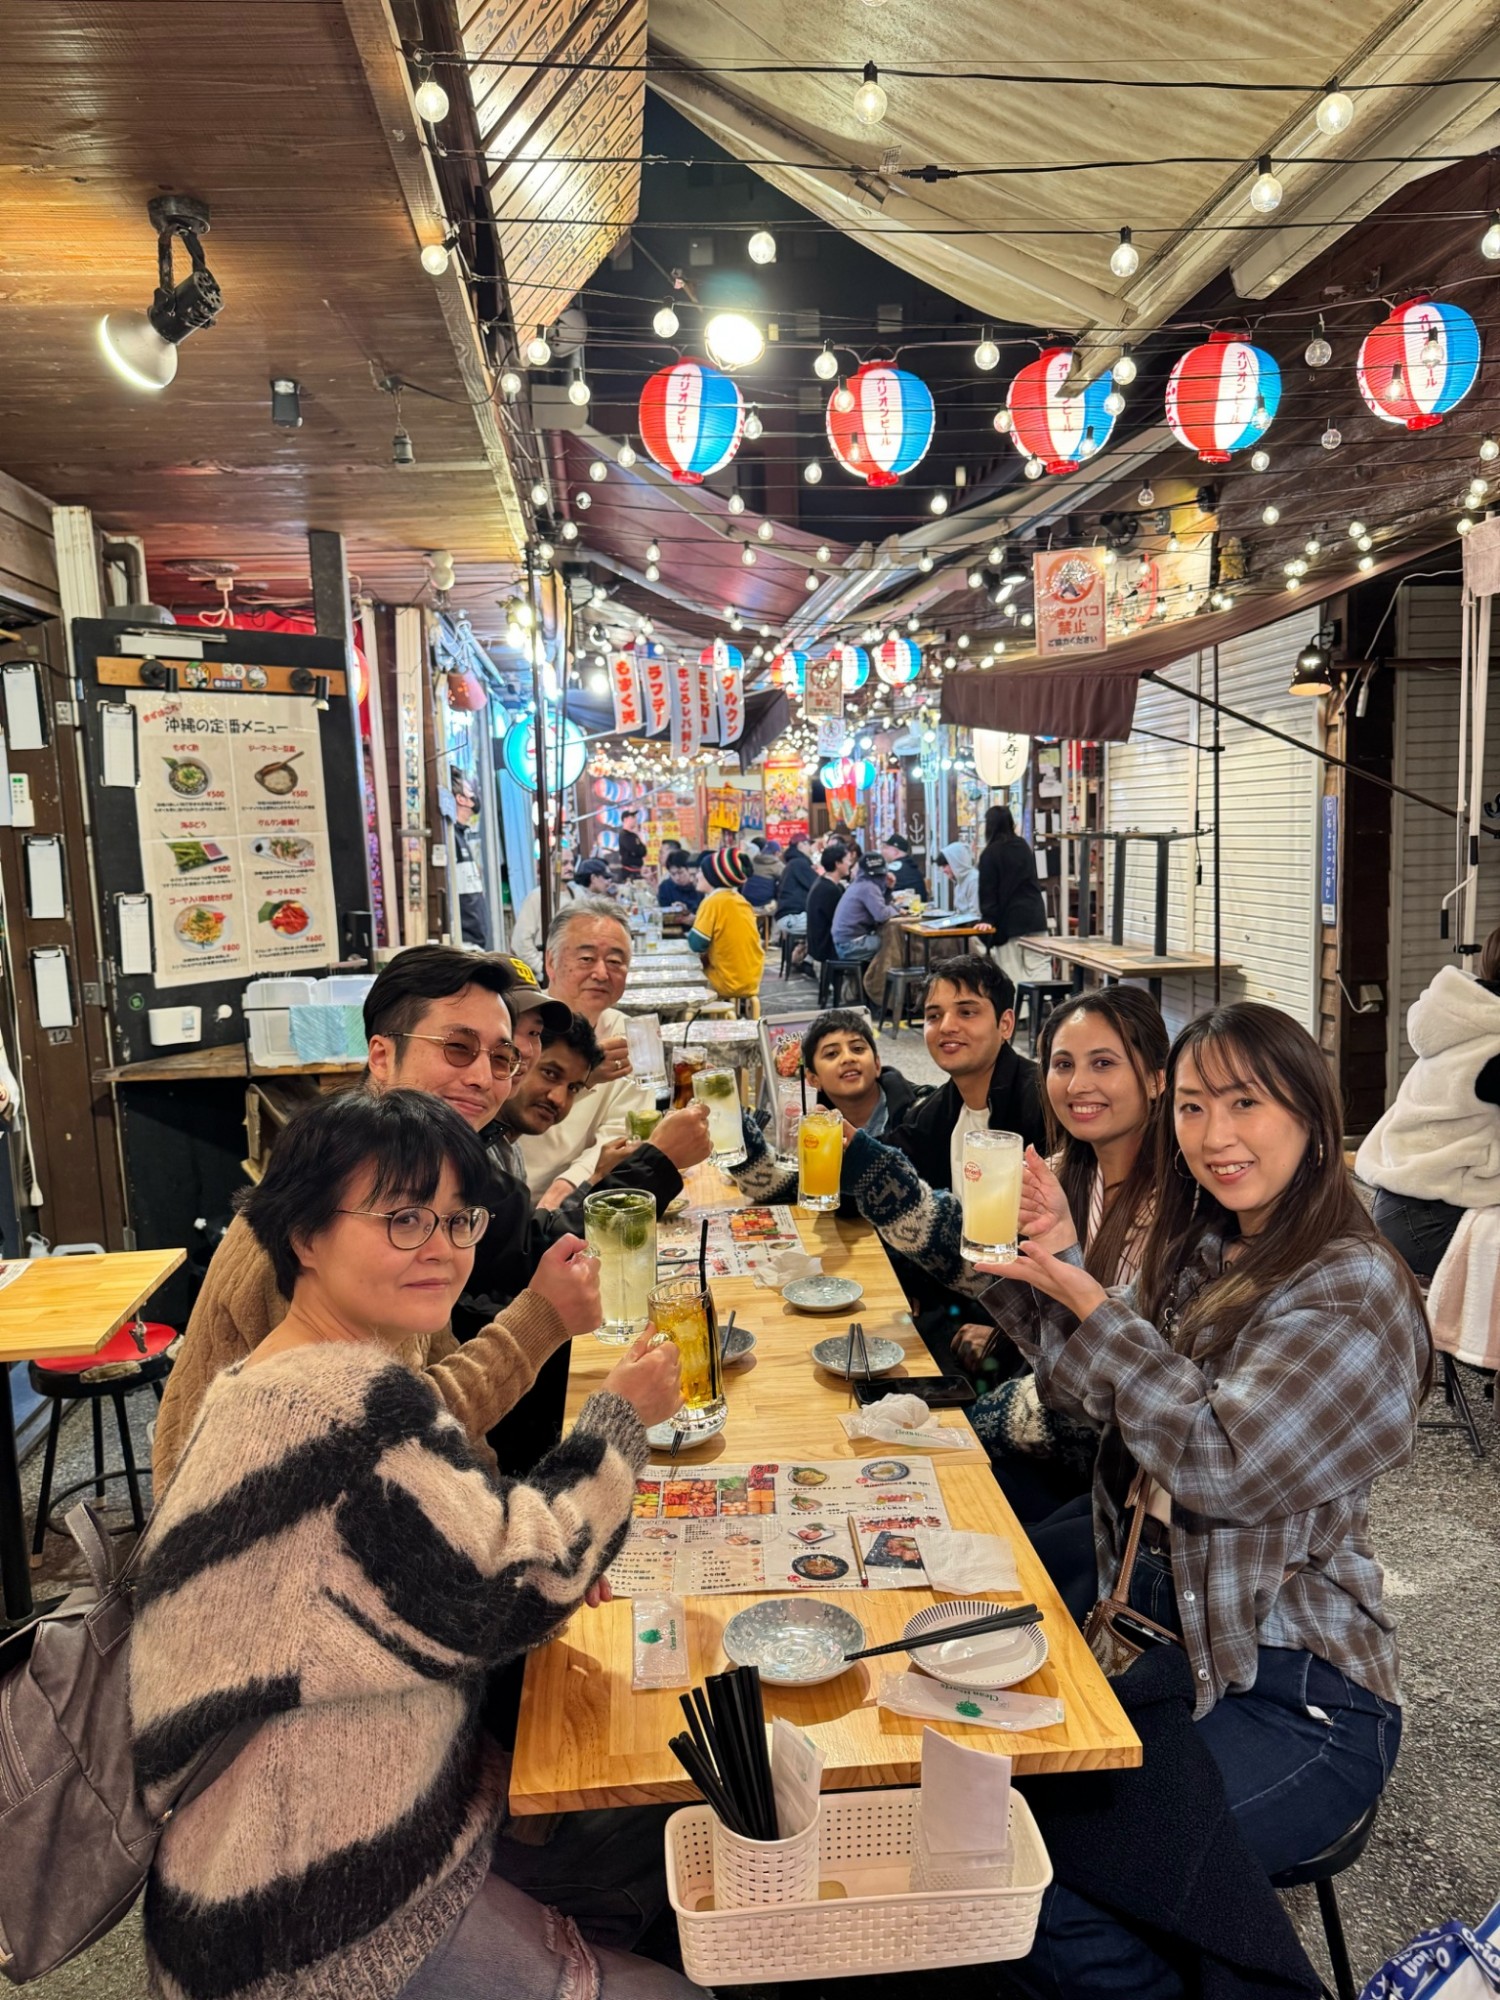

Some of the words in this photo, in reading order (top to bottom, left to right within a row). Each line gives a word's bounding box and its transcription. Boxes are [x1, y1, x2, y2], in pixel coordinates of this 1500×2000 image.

[677, 372, 692, 443] オリオンビール
[876, 377, 892, 446] オリオンビール
[1058, 363, 1074, 432] オビール
[1230, 351, 1248, 424] オリオンビール
[1045, 605, 1100, 620] きタバコ
[1047, 635, 1098, 647] ご協力ください
[1057, 619, 1087, 635] 禁止
[164, 717, 289, 734] 沖縄の定番メニュー
[647, 665, 665, 728] ラフテー
[699, 671, 711, 735] ミミガー
[721, 674, 738, 737] グルクン
[971, 1690, 999, 1702] Clean
[1462, 1927, 1500, 1969] Orio
